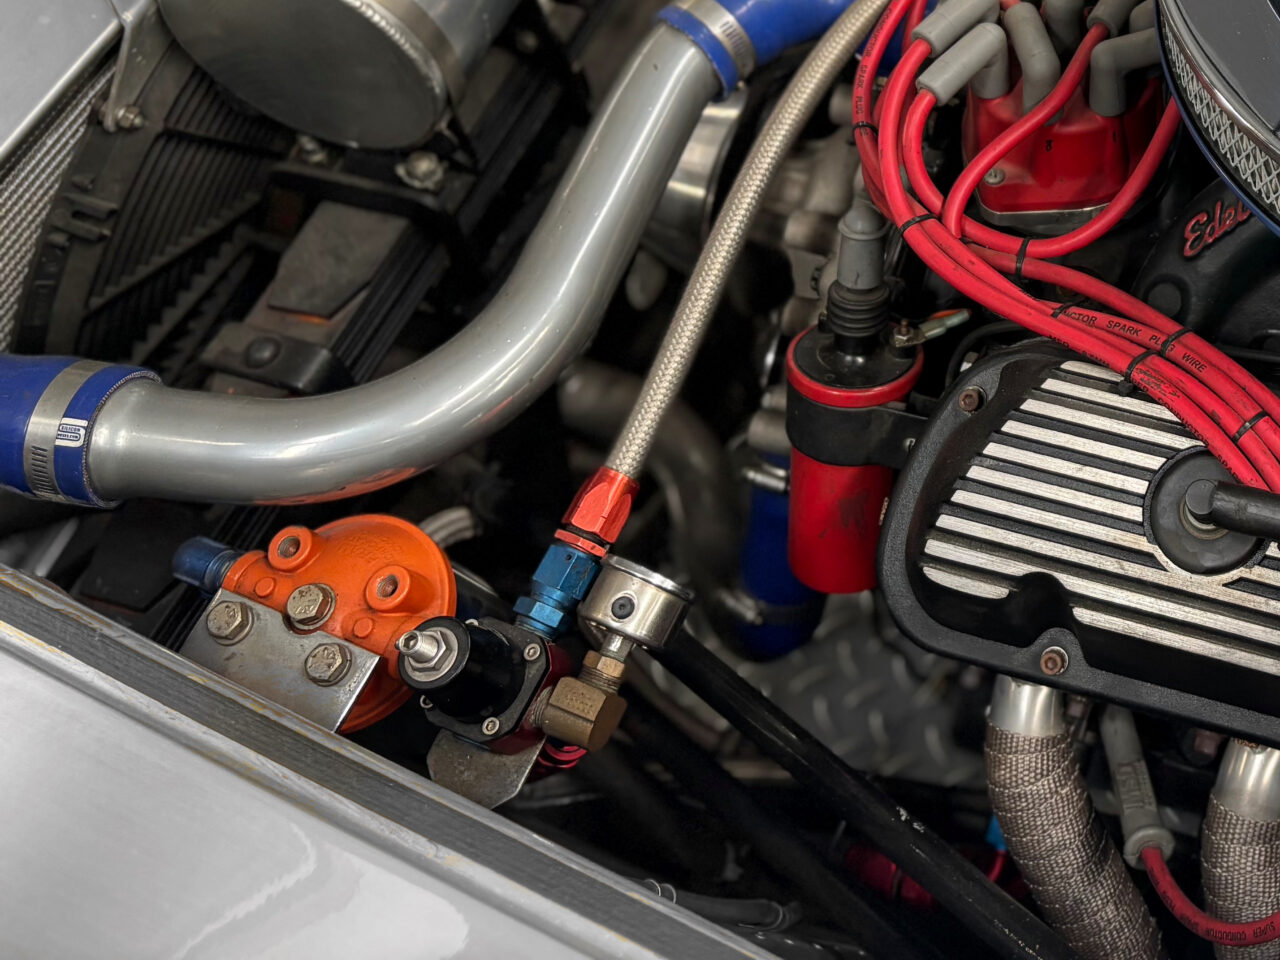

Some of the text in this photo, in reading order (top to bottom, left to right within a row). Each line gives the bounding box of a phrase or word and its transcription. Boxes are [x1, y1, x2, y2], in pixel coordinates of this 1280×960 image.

[1106, 320, 1142, 337] SPARK
[1149, 334, 1176, 352] PLG
[1182, 352, 1208, 373] WIRE
